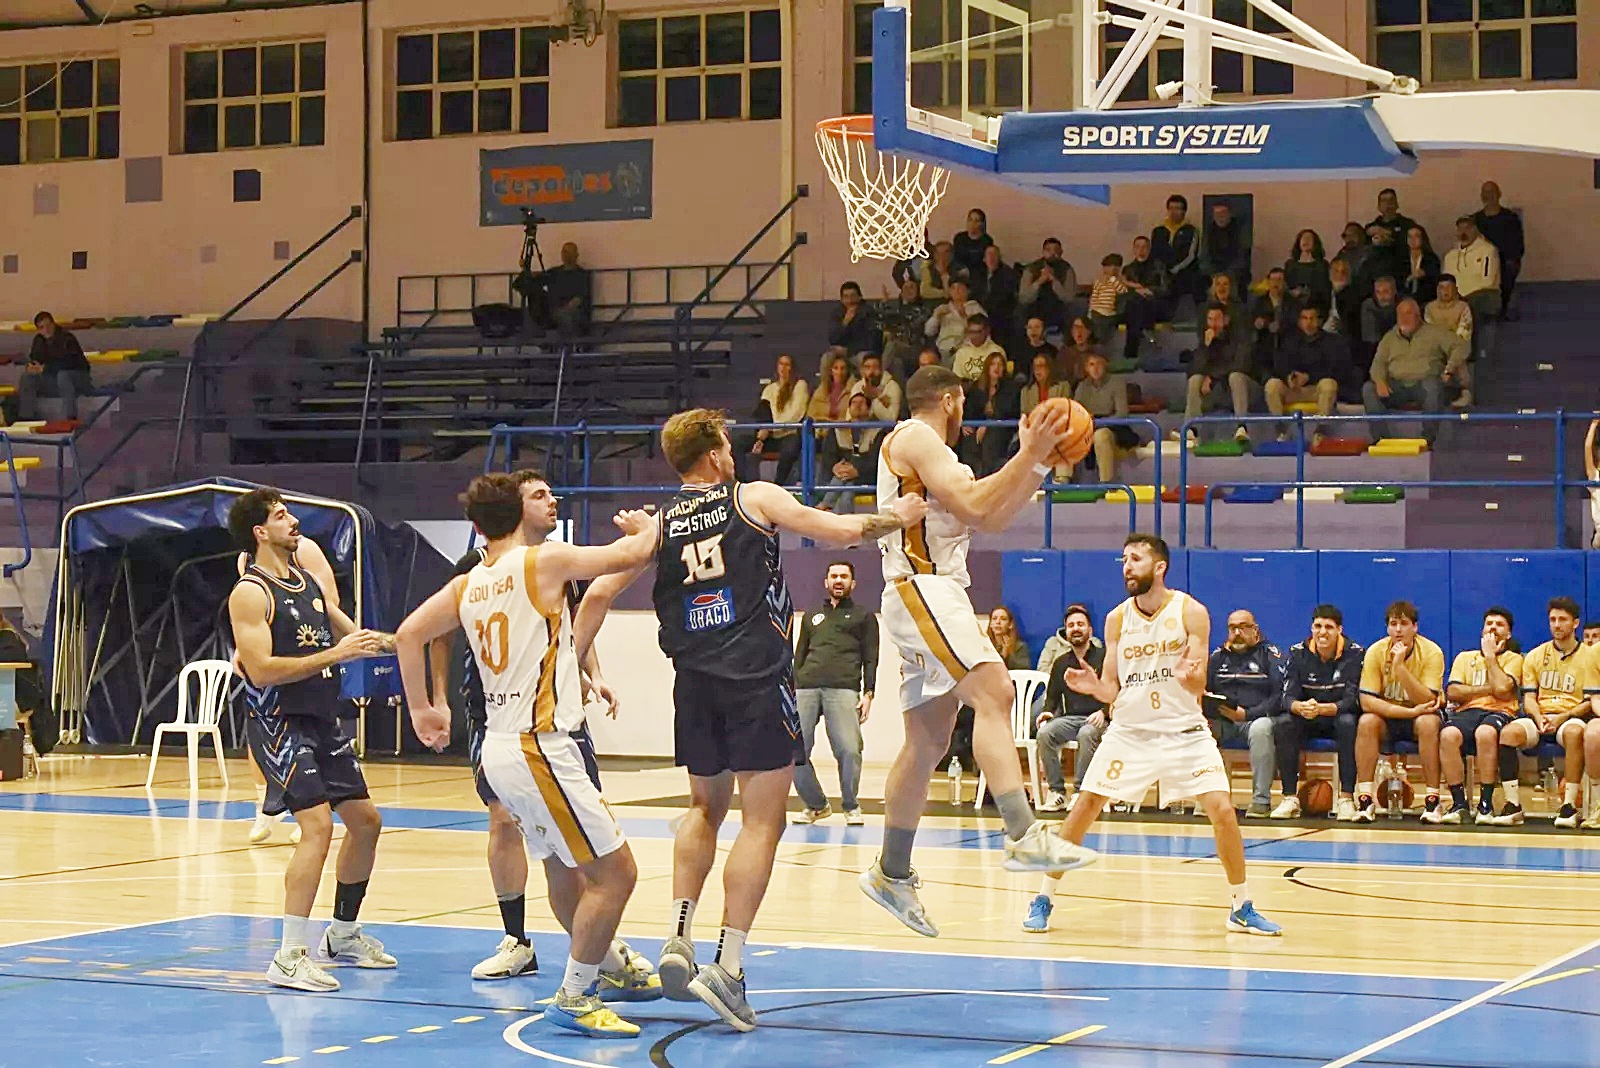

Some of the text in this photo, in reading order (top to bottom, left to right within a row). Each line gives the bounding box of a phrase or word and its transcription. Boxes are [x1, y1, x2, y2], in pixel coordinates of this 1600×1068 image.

[1063, 125, 1270, 153] SPORT SYSTEM
[691, 505, 728, 532] STROG
[680, 533, 726, 585] 15
[475, 611, 509, 675] 10
[1539, 670, 1576, 694] ULB
[1150, 691, 1162, 710] 8
[1106, 759, 1124, 780] 8
